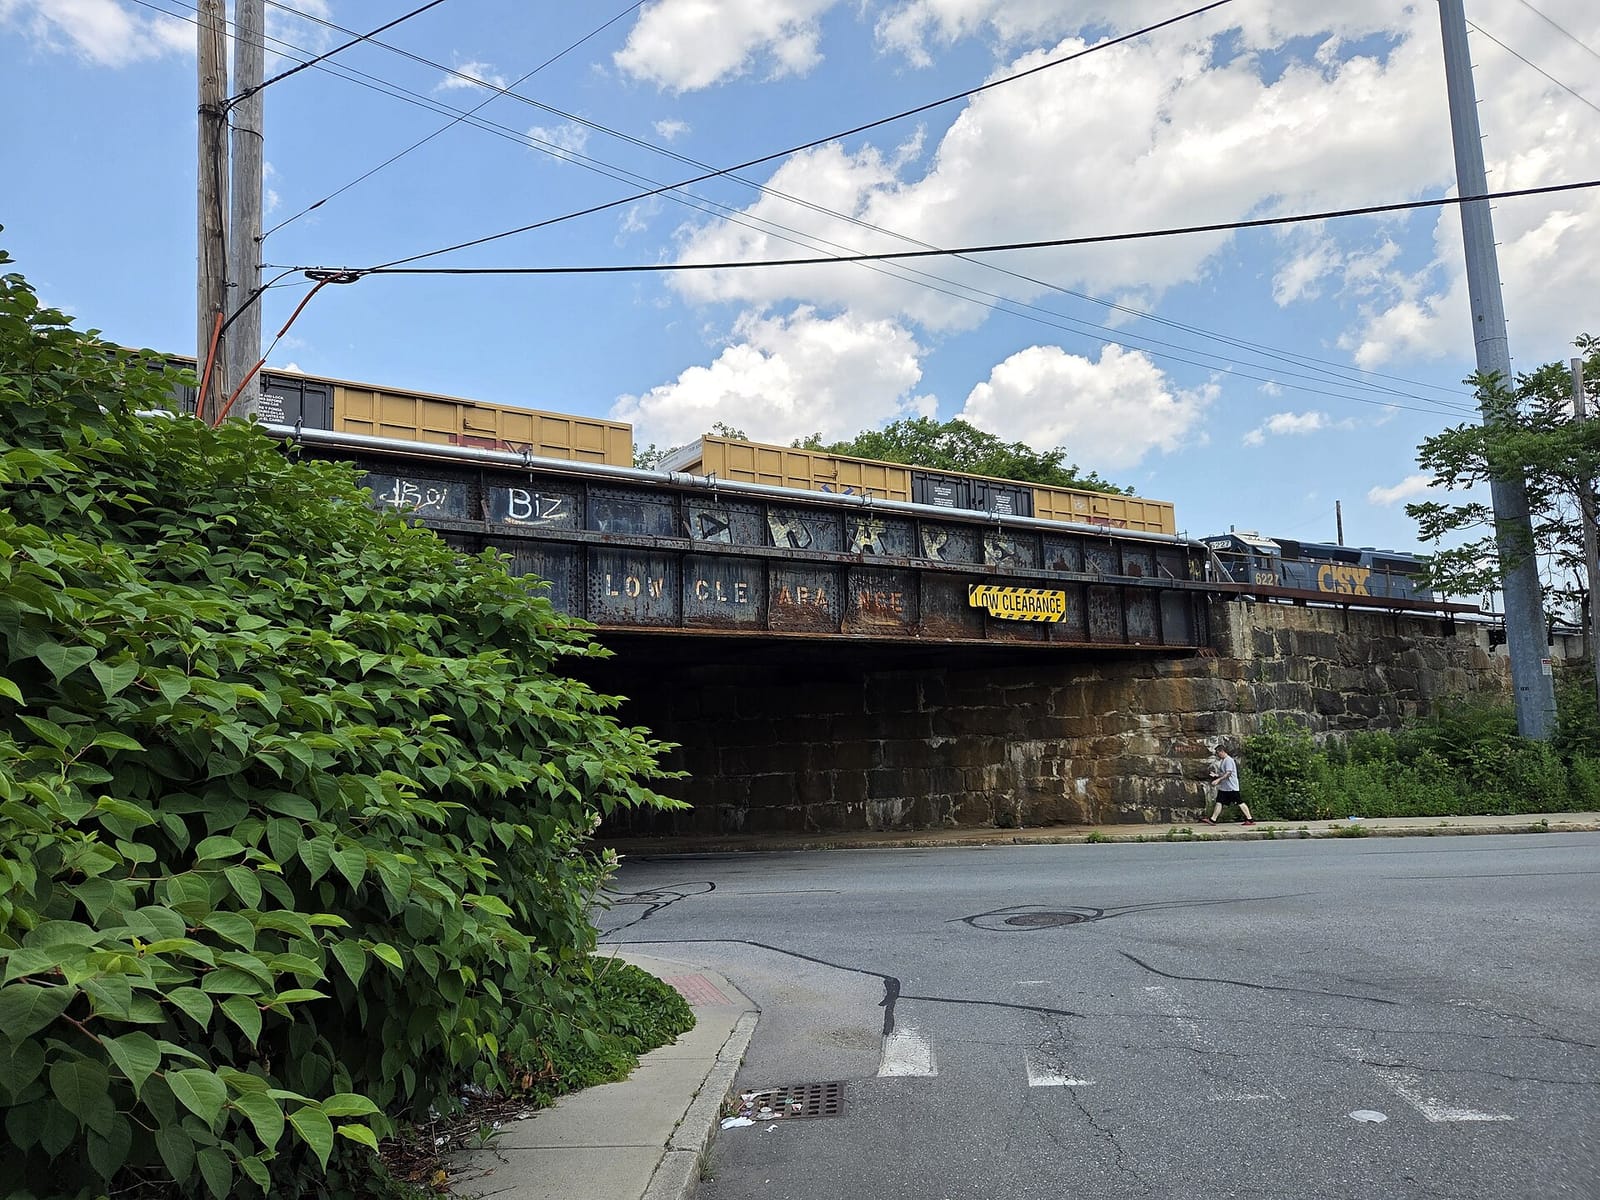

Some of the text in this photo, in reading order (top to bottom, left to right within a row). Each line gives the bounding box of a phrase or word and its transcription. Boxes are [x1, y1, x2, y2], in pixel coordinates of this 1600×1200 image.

[606, 574, 664, 598] LOW
[1318, 565, 1370, 597] CSX
[1002, 594, 1062, 613] CLEARANCE
